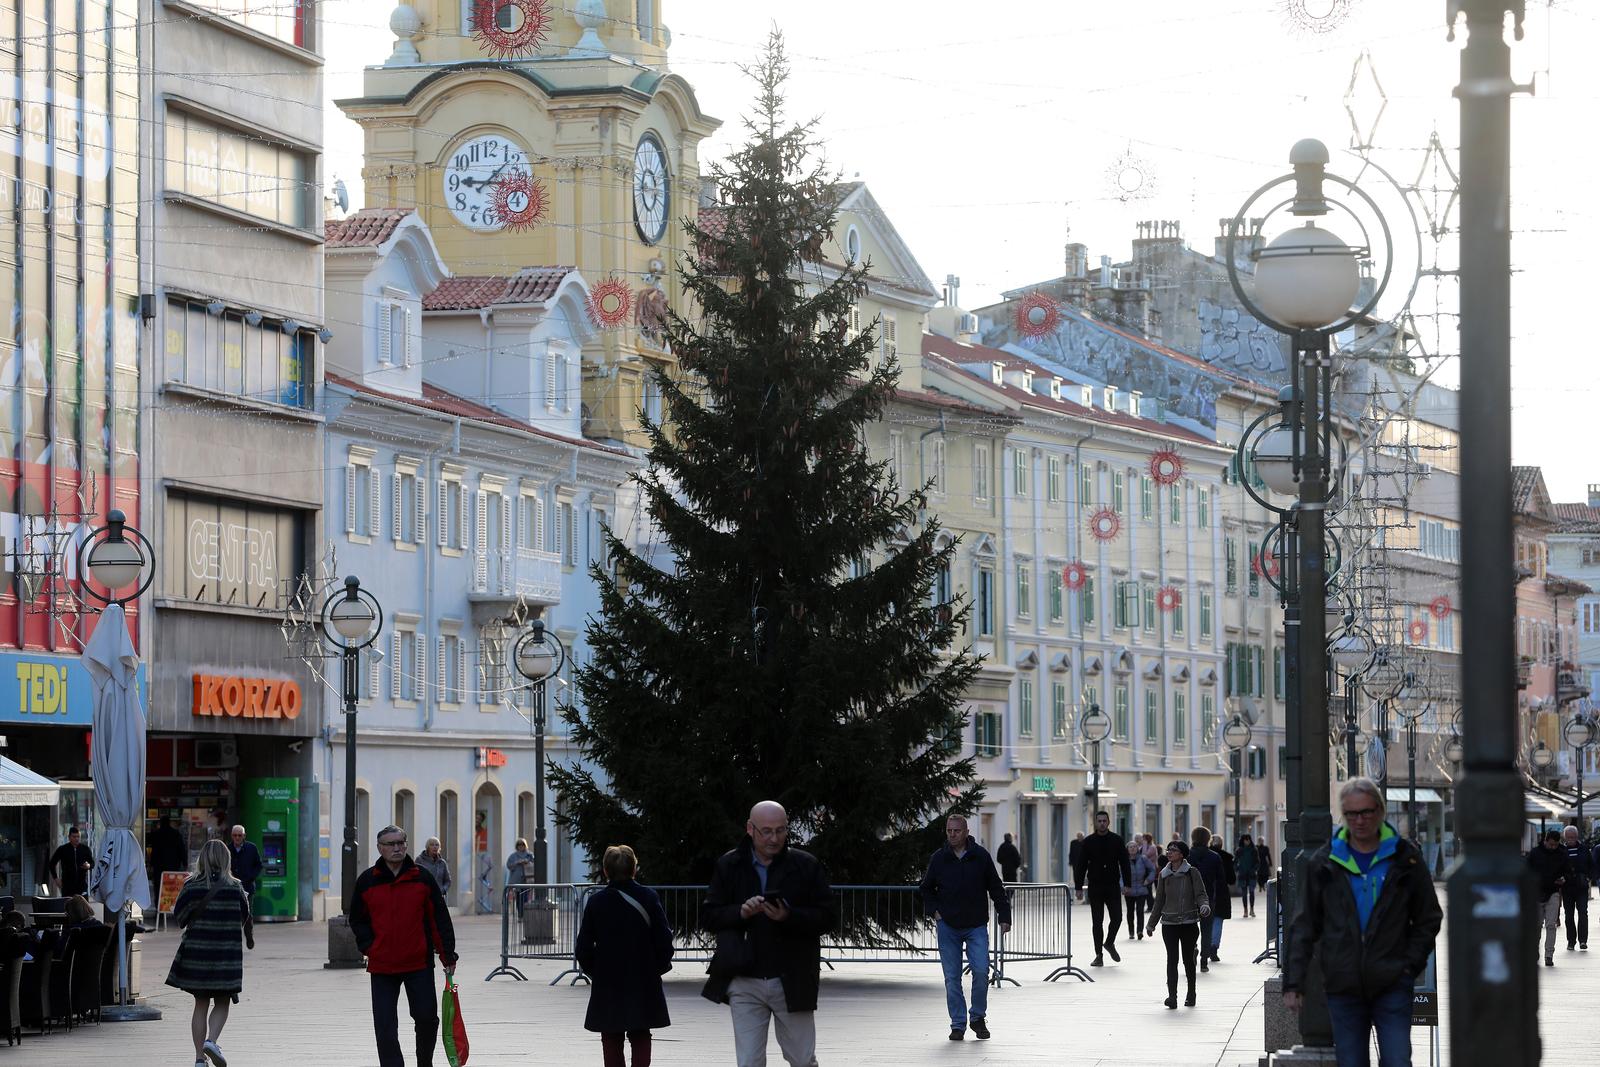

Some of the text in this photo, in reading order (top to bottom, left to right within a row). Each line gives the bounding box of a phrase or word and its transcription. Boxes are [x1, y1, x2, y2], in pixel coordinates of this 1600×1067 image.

[469, 144, 480, 163] 11
[484, 140, 498, 158] 12
[502, 144, 510, 162] 1
[455, 154, 470, 172] 10
[512, 153, 520, 172] 2
[449, 174, 460, 192] 9
[455, 193, 467, 211] 8
[510, 192, 520, 207] 4
[470, 205, 481, 223] 7
[188, 519, 279, 588] CENTRA
[17, 662, 67, 714] TEDi
[195, 673, 302, 720] KORZO
